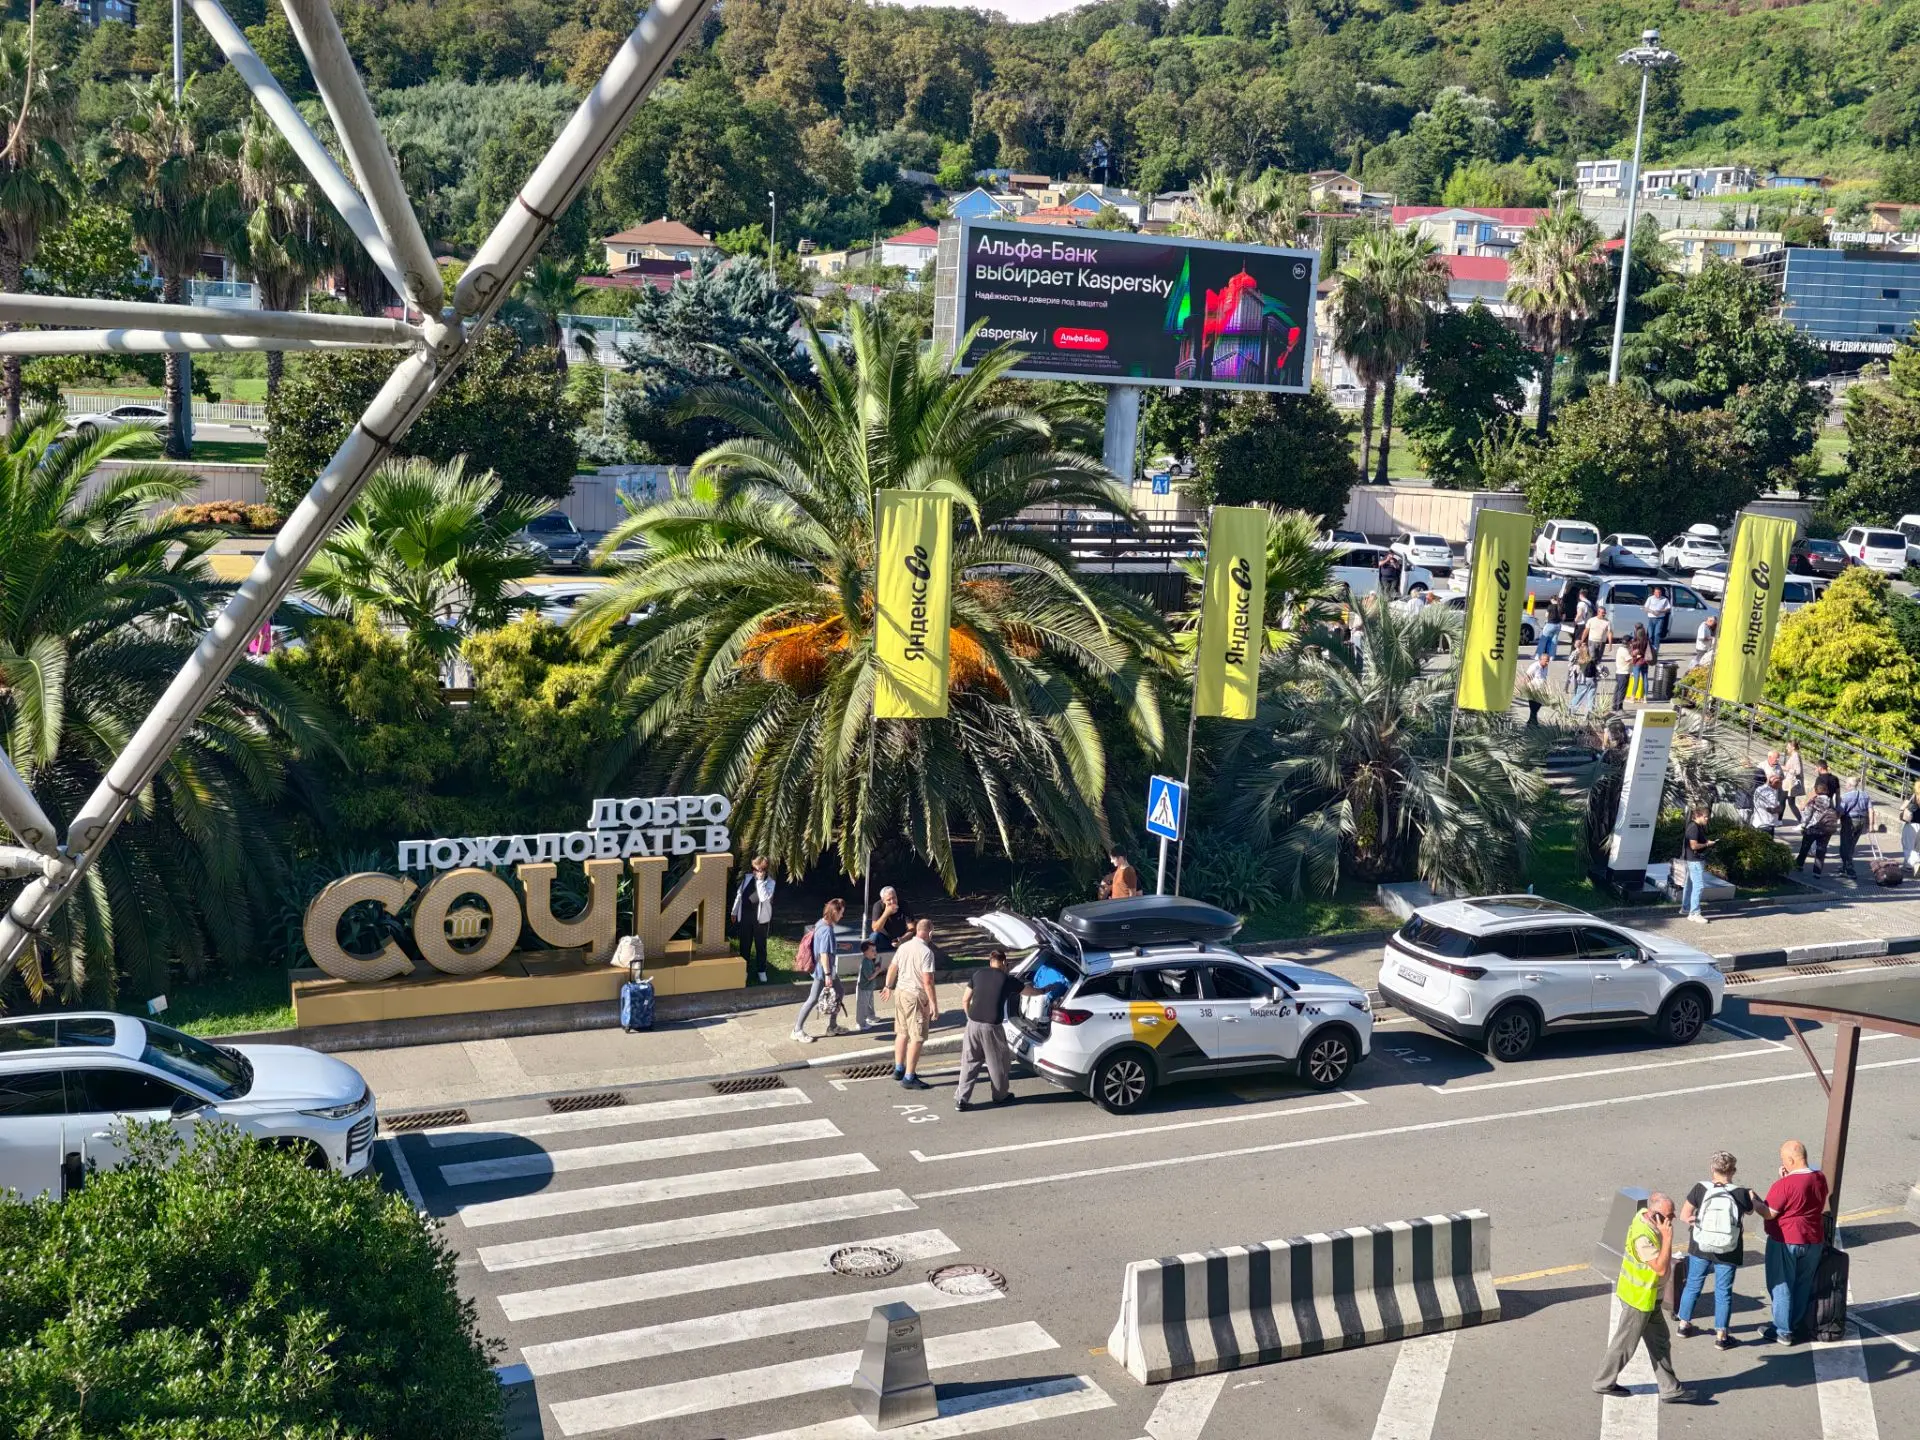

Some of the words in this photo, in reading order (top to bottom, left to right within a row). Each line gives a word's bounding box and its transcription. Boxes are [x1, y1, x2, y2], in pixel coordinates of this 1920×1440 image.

[976, 234, 1099, 264] Альфа-Банк
[975, 261, 1075, 288] выбирает
[1077, 268, 1175, 299] Kaspersky
[974, 290, 1022, 303] Надёжность
[1022, 294, 1028, 302] и
[1028, 295, 1061, 307] доверие
[1061, 298, 1076, 308] под
[1076, 299, 1109, 309] защитой
[1060, 332, 1084, 344] Альфа
[1084, 333, 1102, 343] Банк
[1829, 340, 1897, 355] НЕДВИЖИМОСТ
[904, 544, 931, 581] Go
[1231, 557, 1252, 591] Go
[1494, 559, 1512, 591] Go
[1751, 560, 1771, 591] Go
[904, 582, 929, 662] Яндекс
[1224, 592, 1250, 666] Яндекс
[1489, 593, 1508, 662] Яндекс
[1742, 591, 1767, 656] Яндекс
[587, 793, 732, 829] ДОБРО
[397, 828, 697, 872] ПОЖАЛОВАТЬ
[705, 825, 731, 853] В
[303, 853, 735, 984] СОЧИ
[1165, 1007, 1175, 1019] Я
[1199, 1008, 1213, 1018] 318
[1249, 1007, 1278, 1018] Яндекс
[1279, 1005, 1292, 1018] Go
